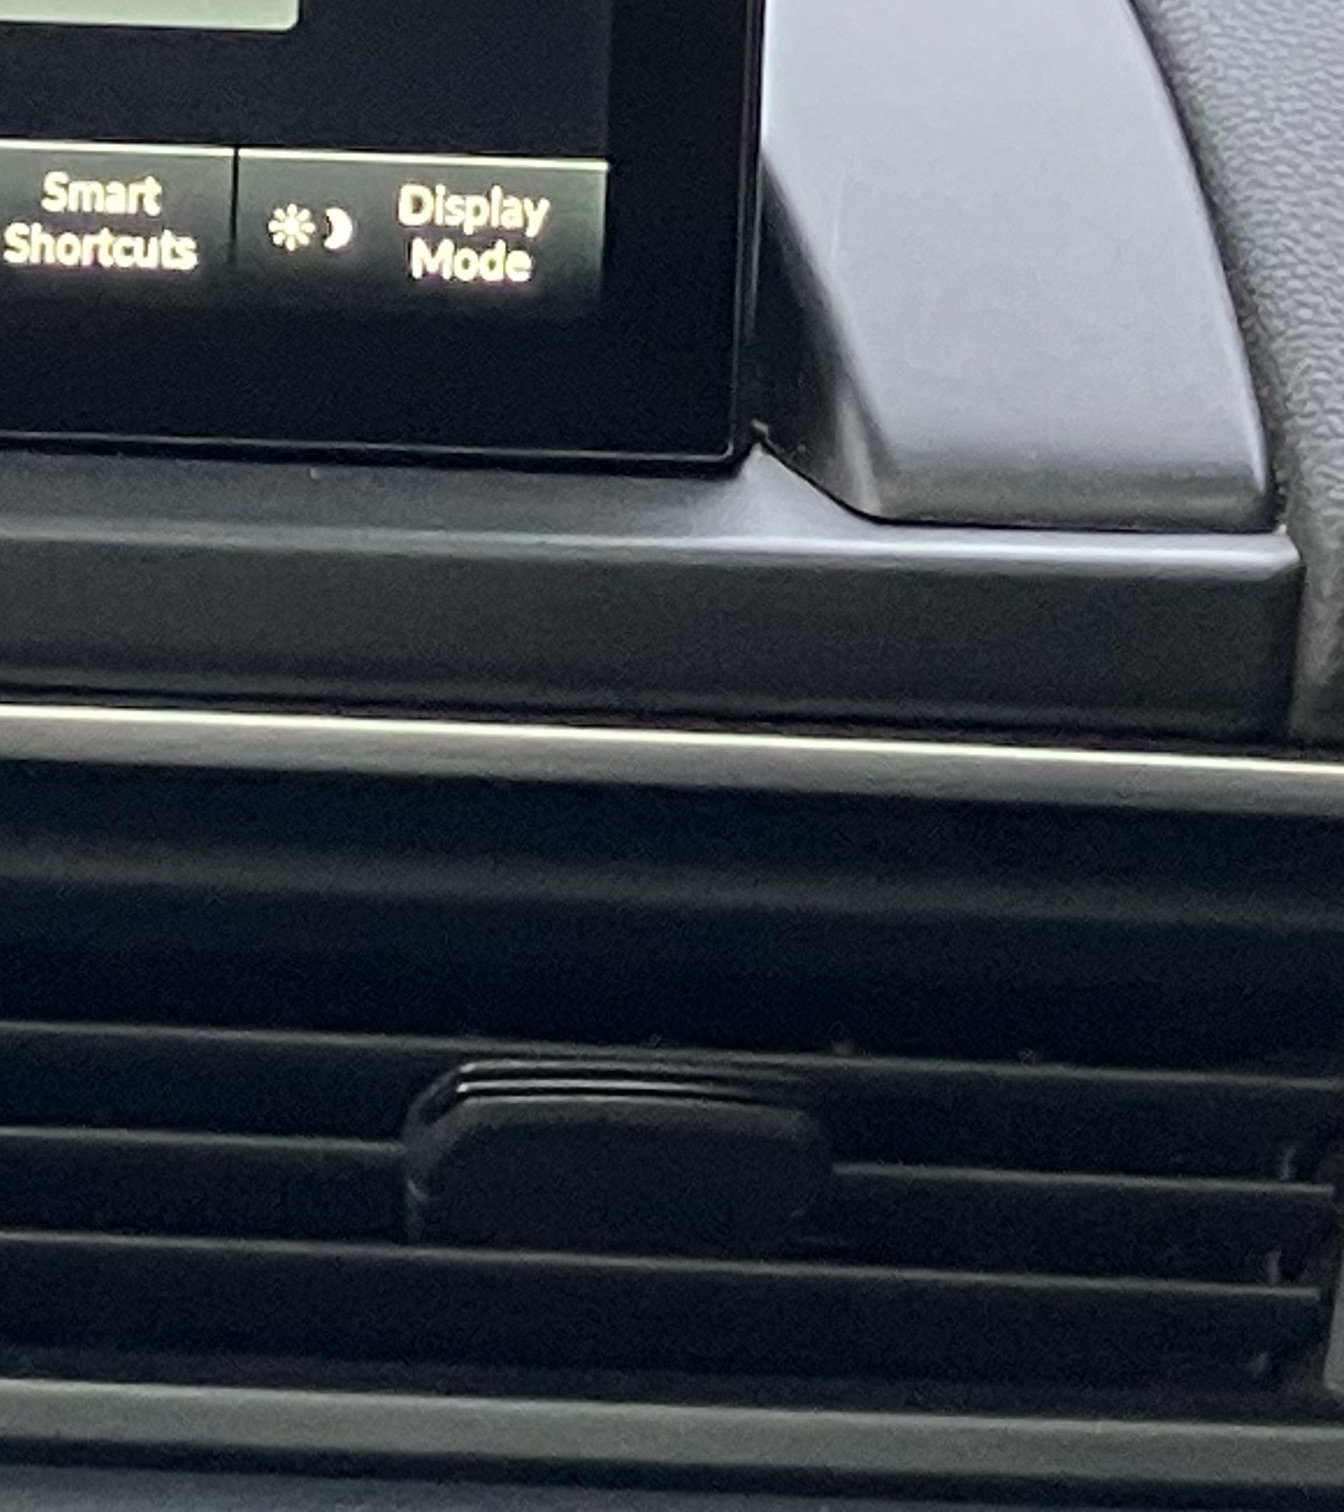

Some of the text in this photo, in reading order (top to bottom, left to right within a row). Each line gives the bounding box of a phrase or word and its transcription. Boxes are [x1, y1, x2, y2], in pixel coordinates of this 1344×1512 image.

[41, 171, 162, 217] Smart
[397, 183, 552, 239] Display
[3, 222, 199, 271] Shortcuts
[410, 235, 533, 284] Mode
